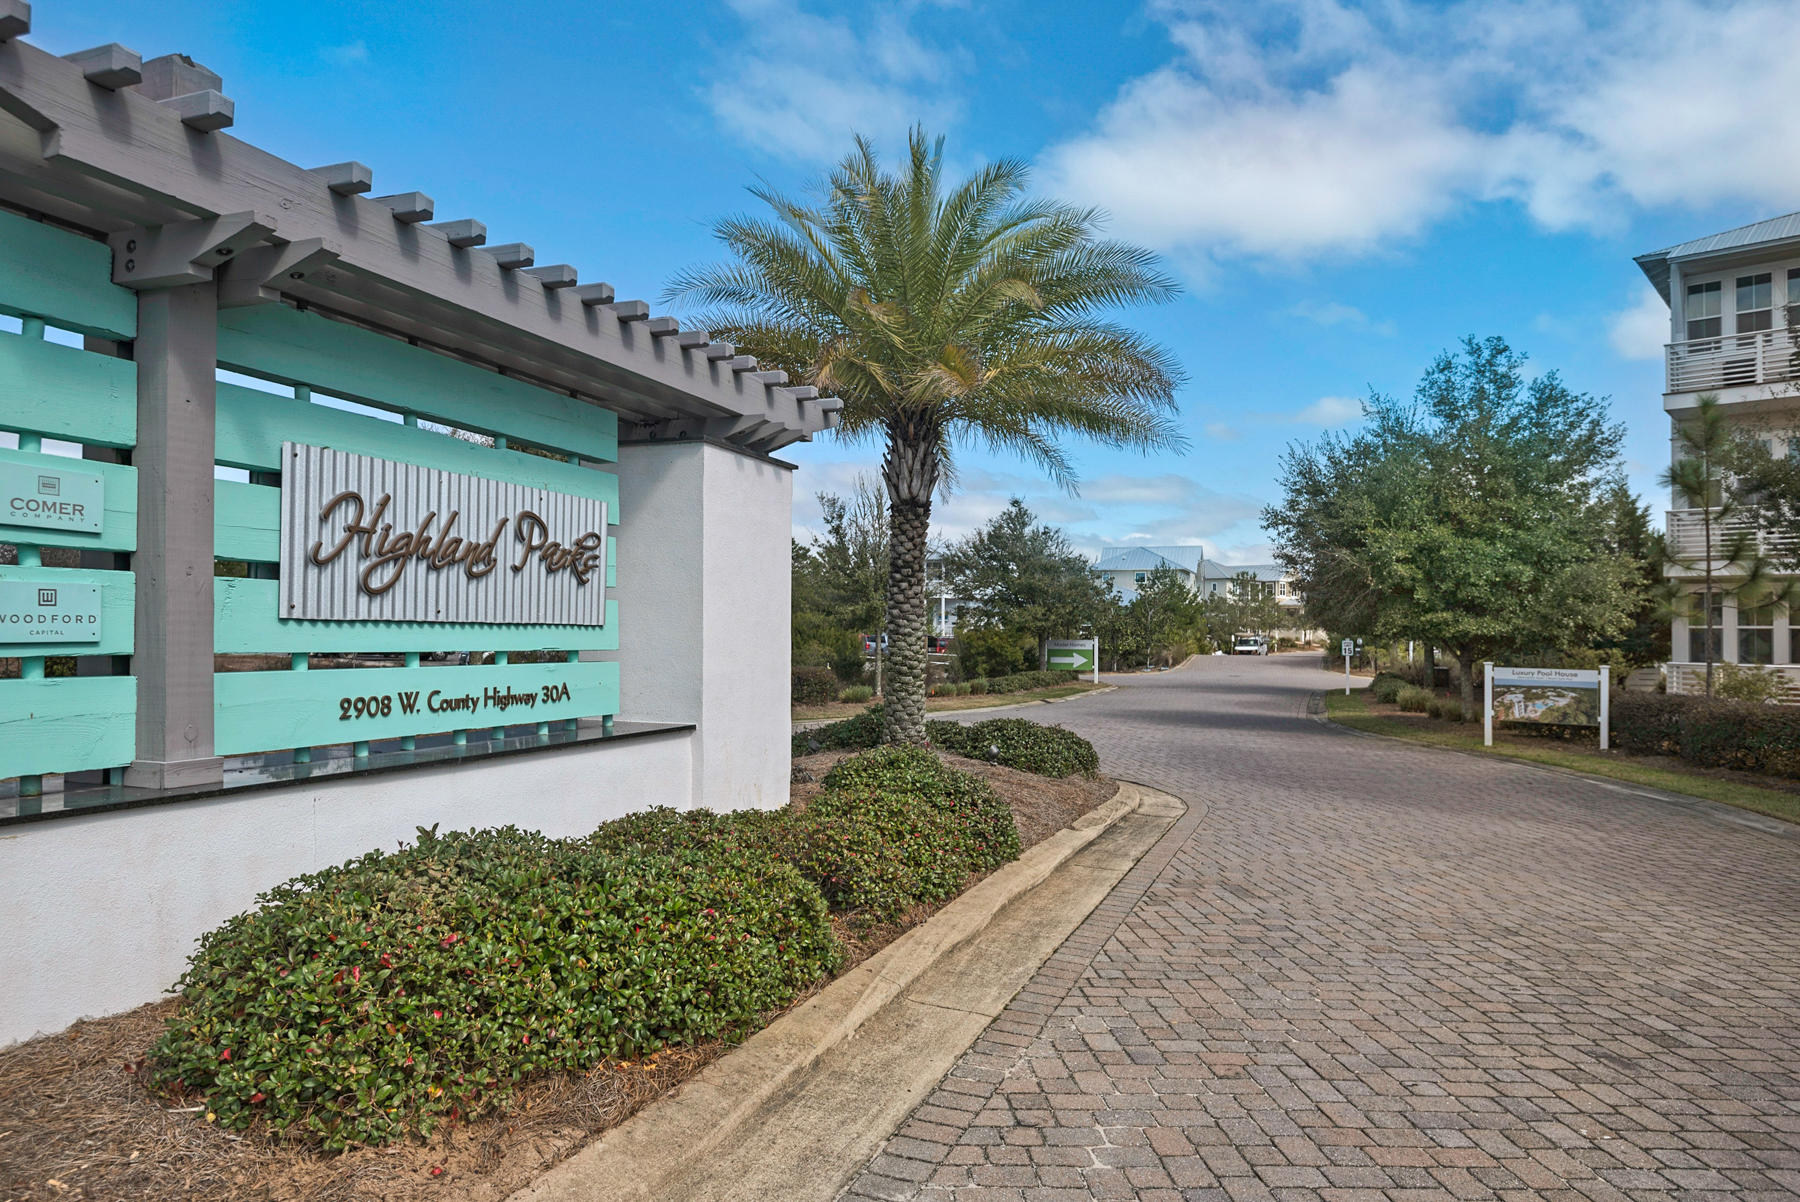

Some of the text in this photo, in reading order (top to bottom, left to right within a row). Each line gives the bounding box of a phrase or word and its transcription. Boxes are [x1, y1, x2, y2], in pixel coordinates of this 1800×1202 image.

[10, 497, 85, 516] COMER
[10, 511, 85, 522] COMPANY
[310, 491, 602, 595] Highland Parks
[1512, 669, 1535, 677] Luxury
[1536, 669, 1553, 677] Pool
[339, 682, 571, 721] 2908 W. County Highway 30A
